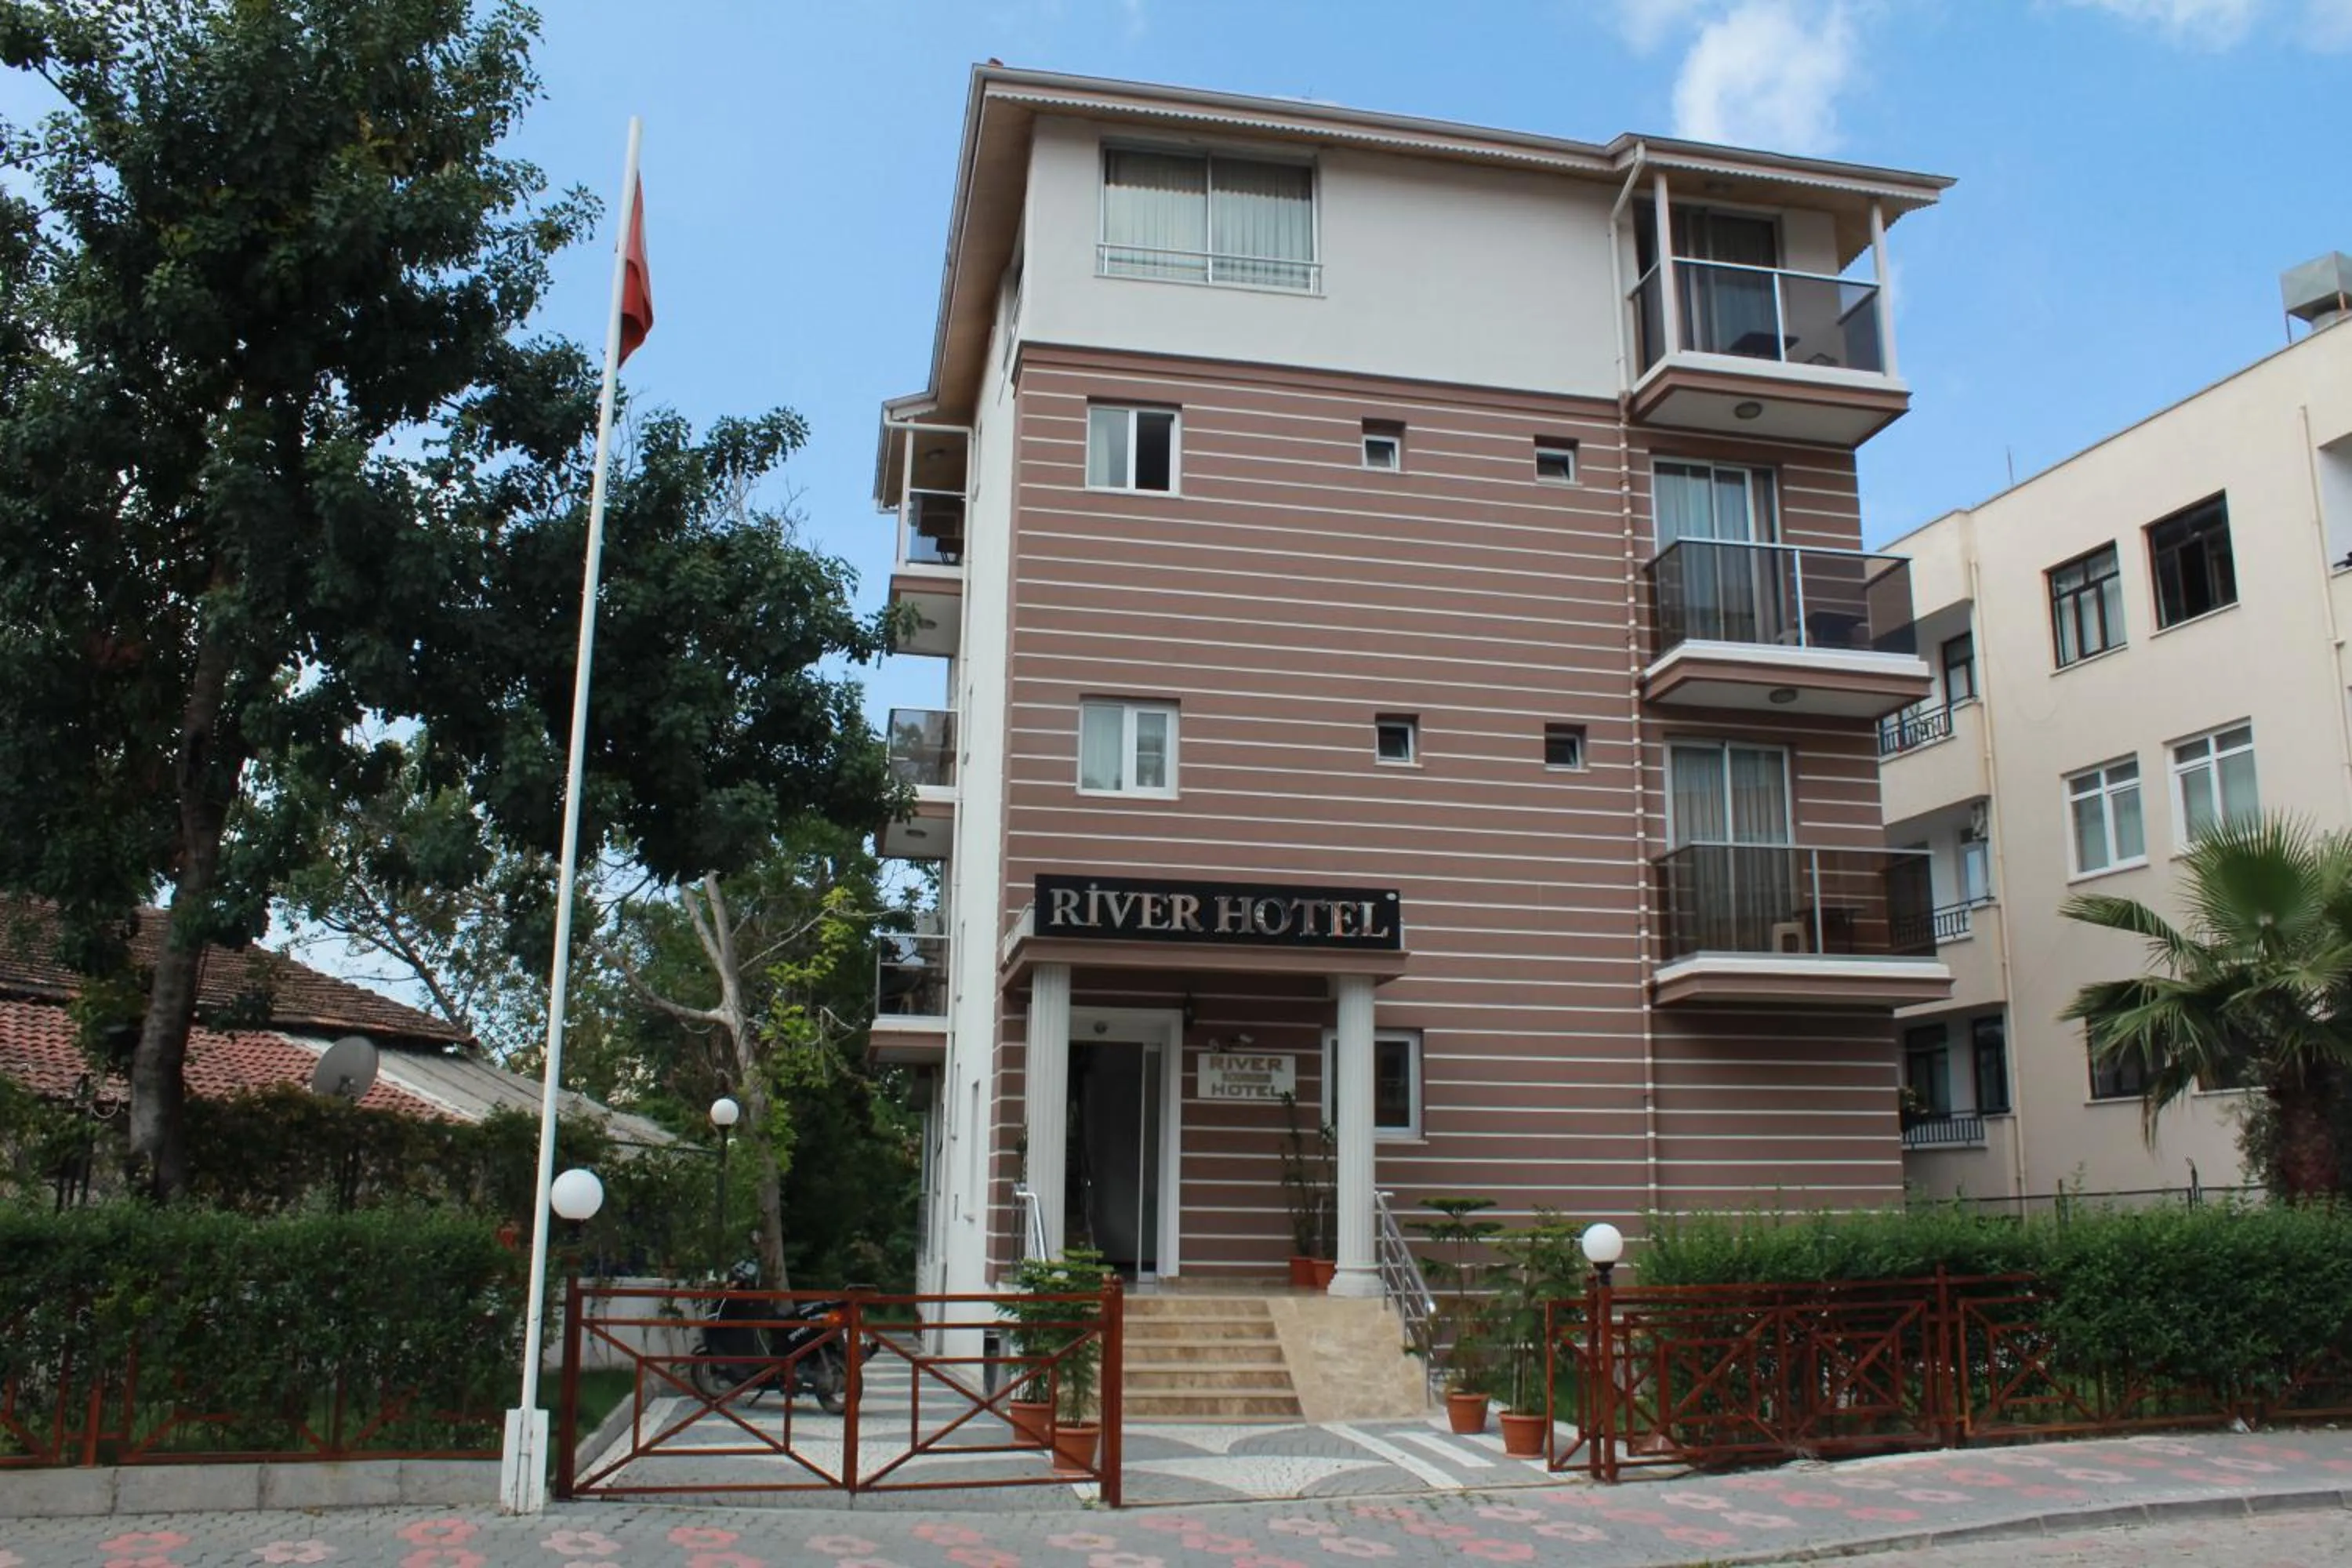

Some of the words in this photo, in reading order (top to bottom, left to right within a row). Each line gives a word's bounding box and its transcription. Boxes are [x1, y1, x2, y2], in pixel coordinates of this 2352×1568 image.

[1214, 895, 1388, 938] HOTEL
[1209, 1055, 1283, 1072] RIVER
[1211, 1083, 1283, 1097] HOTEL
